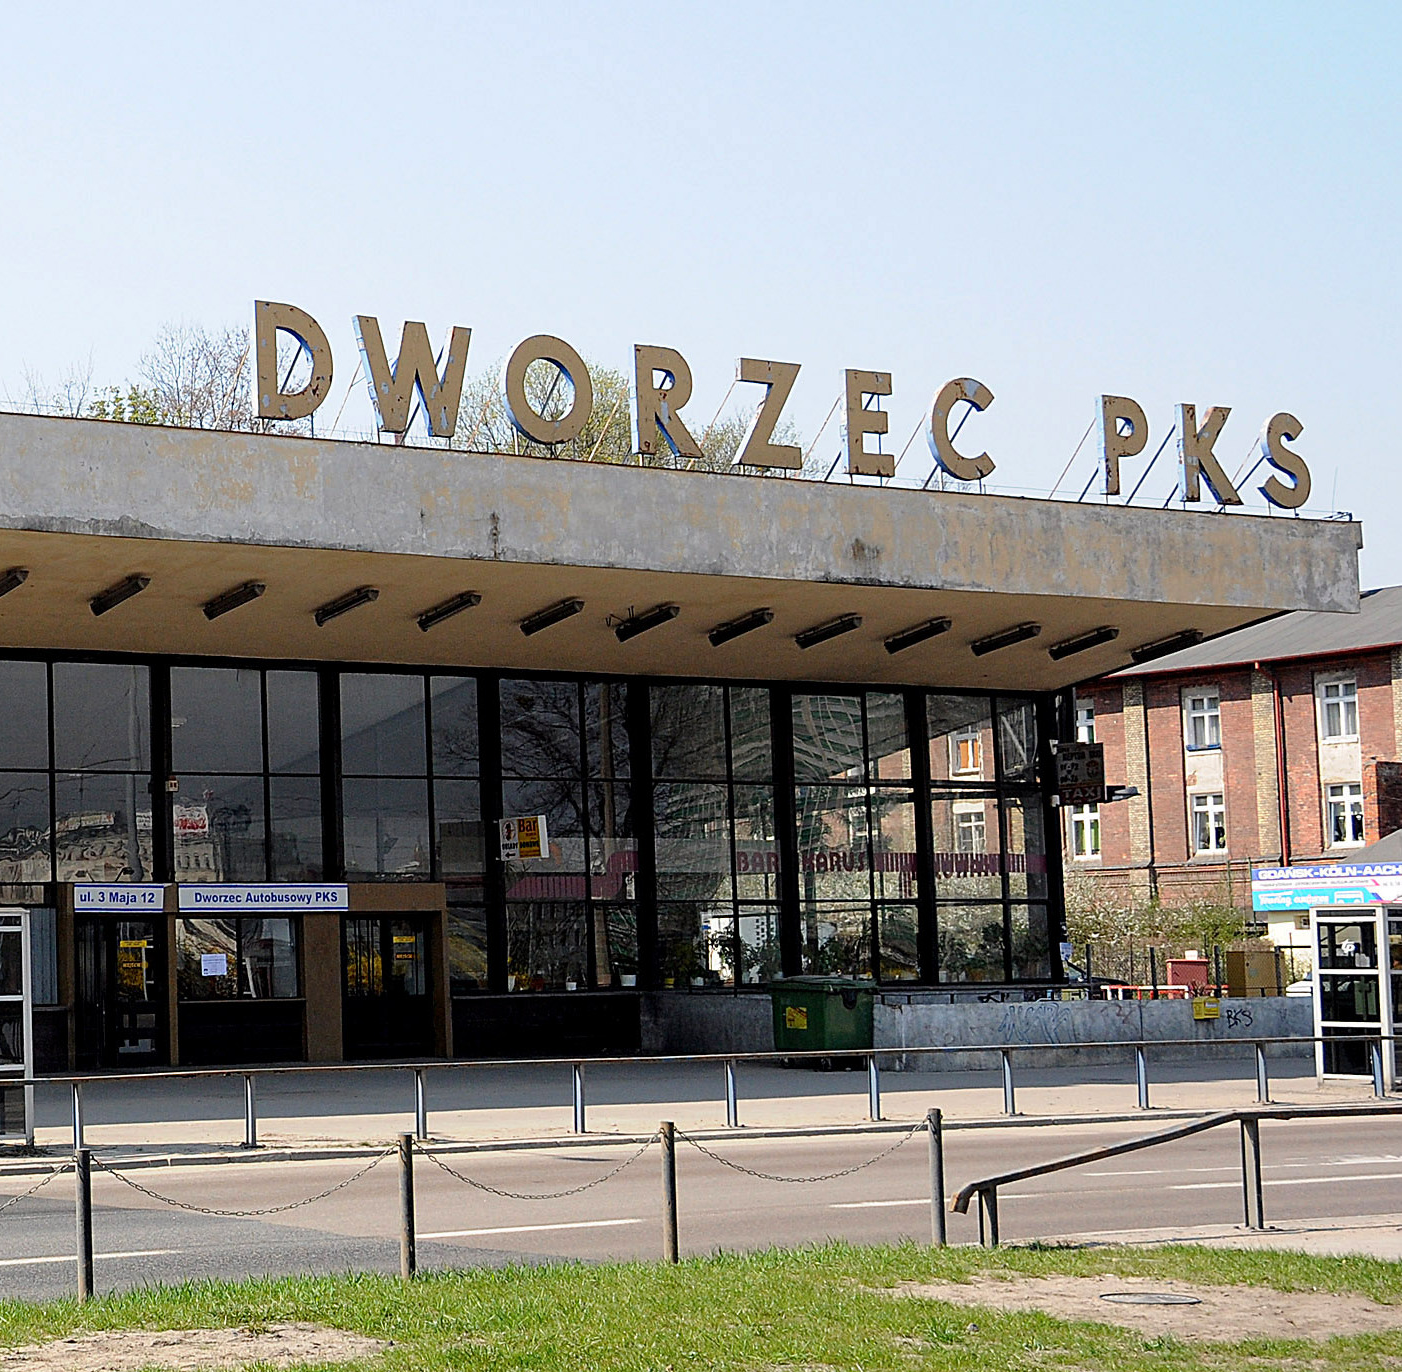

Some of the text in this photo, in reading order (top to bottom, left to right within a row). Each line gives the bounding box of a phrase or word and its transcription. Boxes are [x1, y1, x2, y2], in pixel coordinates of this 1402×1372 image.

[254, 299, 1313, 510] DWORZEC PKS
[518, 818, 538, 833] Bar
[736, 851, 866, 873] BAR KARUS
[79, 892, 155, 905] ul. 3 Maja 12
[194, 892, 338, 905] Dworzec Autobusowy PKS
